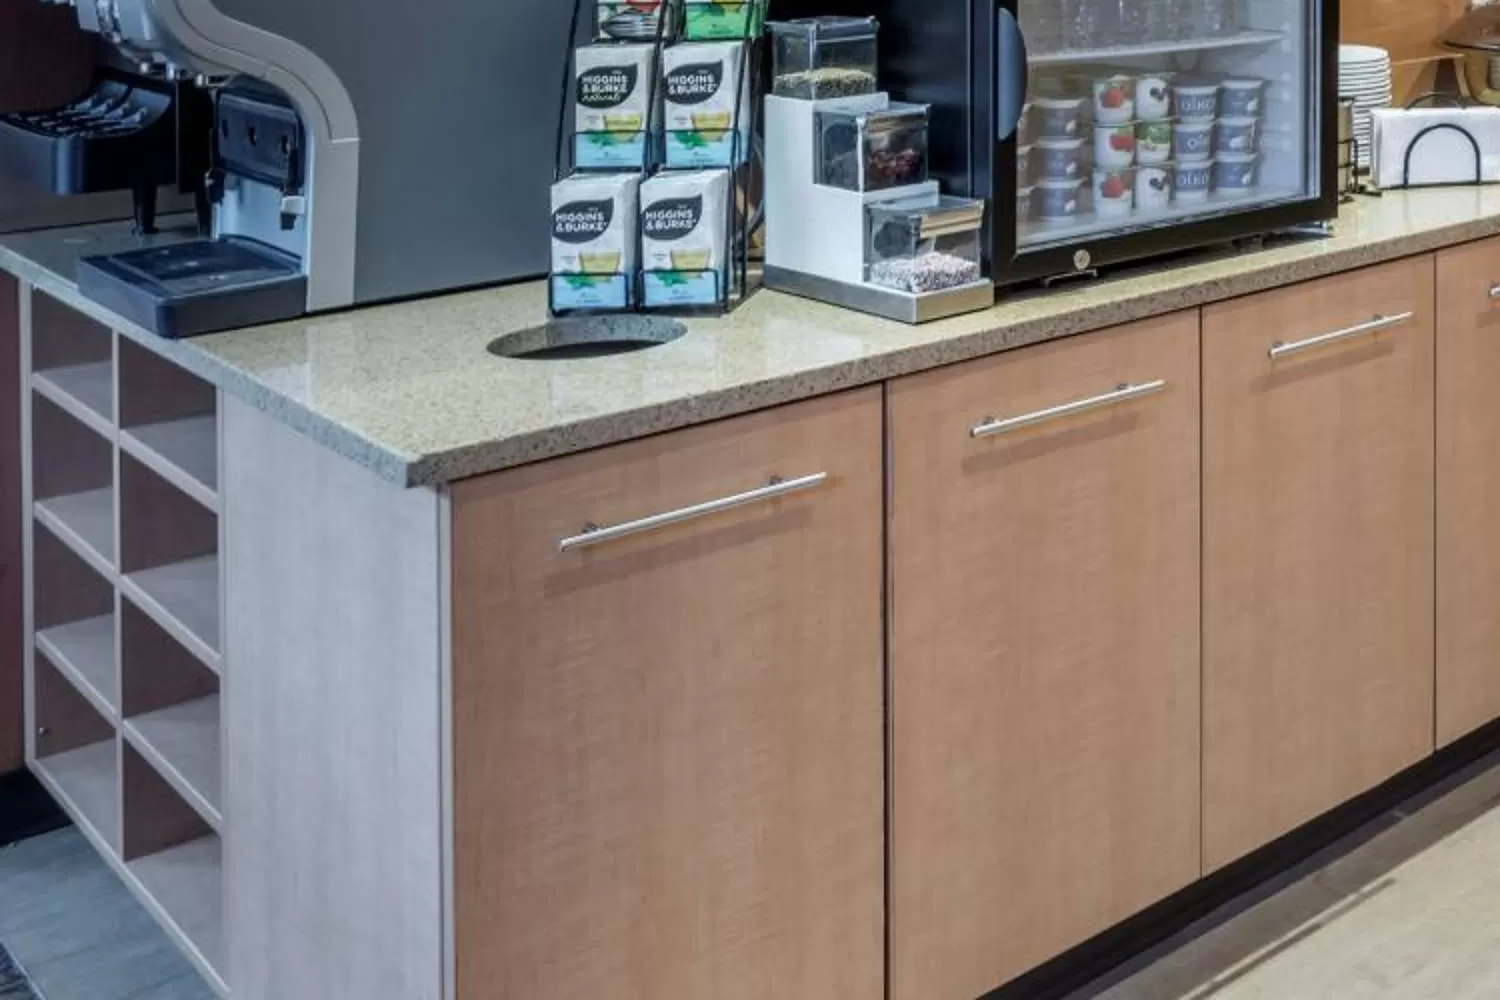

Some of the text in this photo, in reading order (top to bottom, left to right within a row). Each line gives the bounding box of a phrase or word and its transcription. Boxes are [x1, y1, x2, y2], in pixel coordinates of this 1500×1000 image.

[582, 75, 628, 85] HIGGINS
[668, 74, 714, 85] HIGGINS
[555, 212, 604, 222] HIGGINS
[645, 209, 693, 220] HIGGINS
